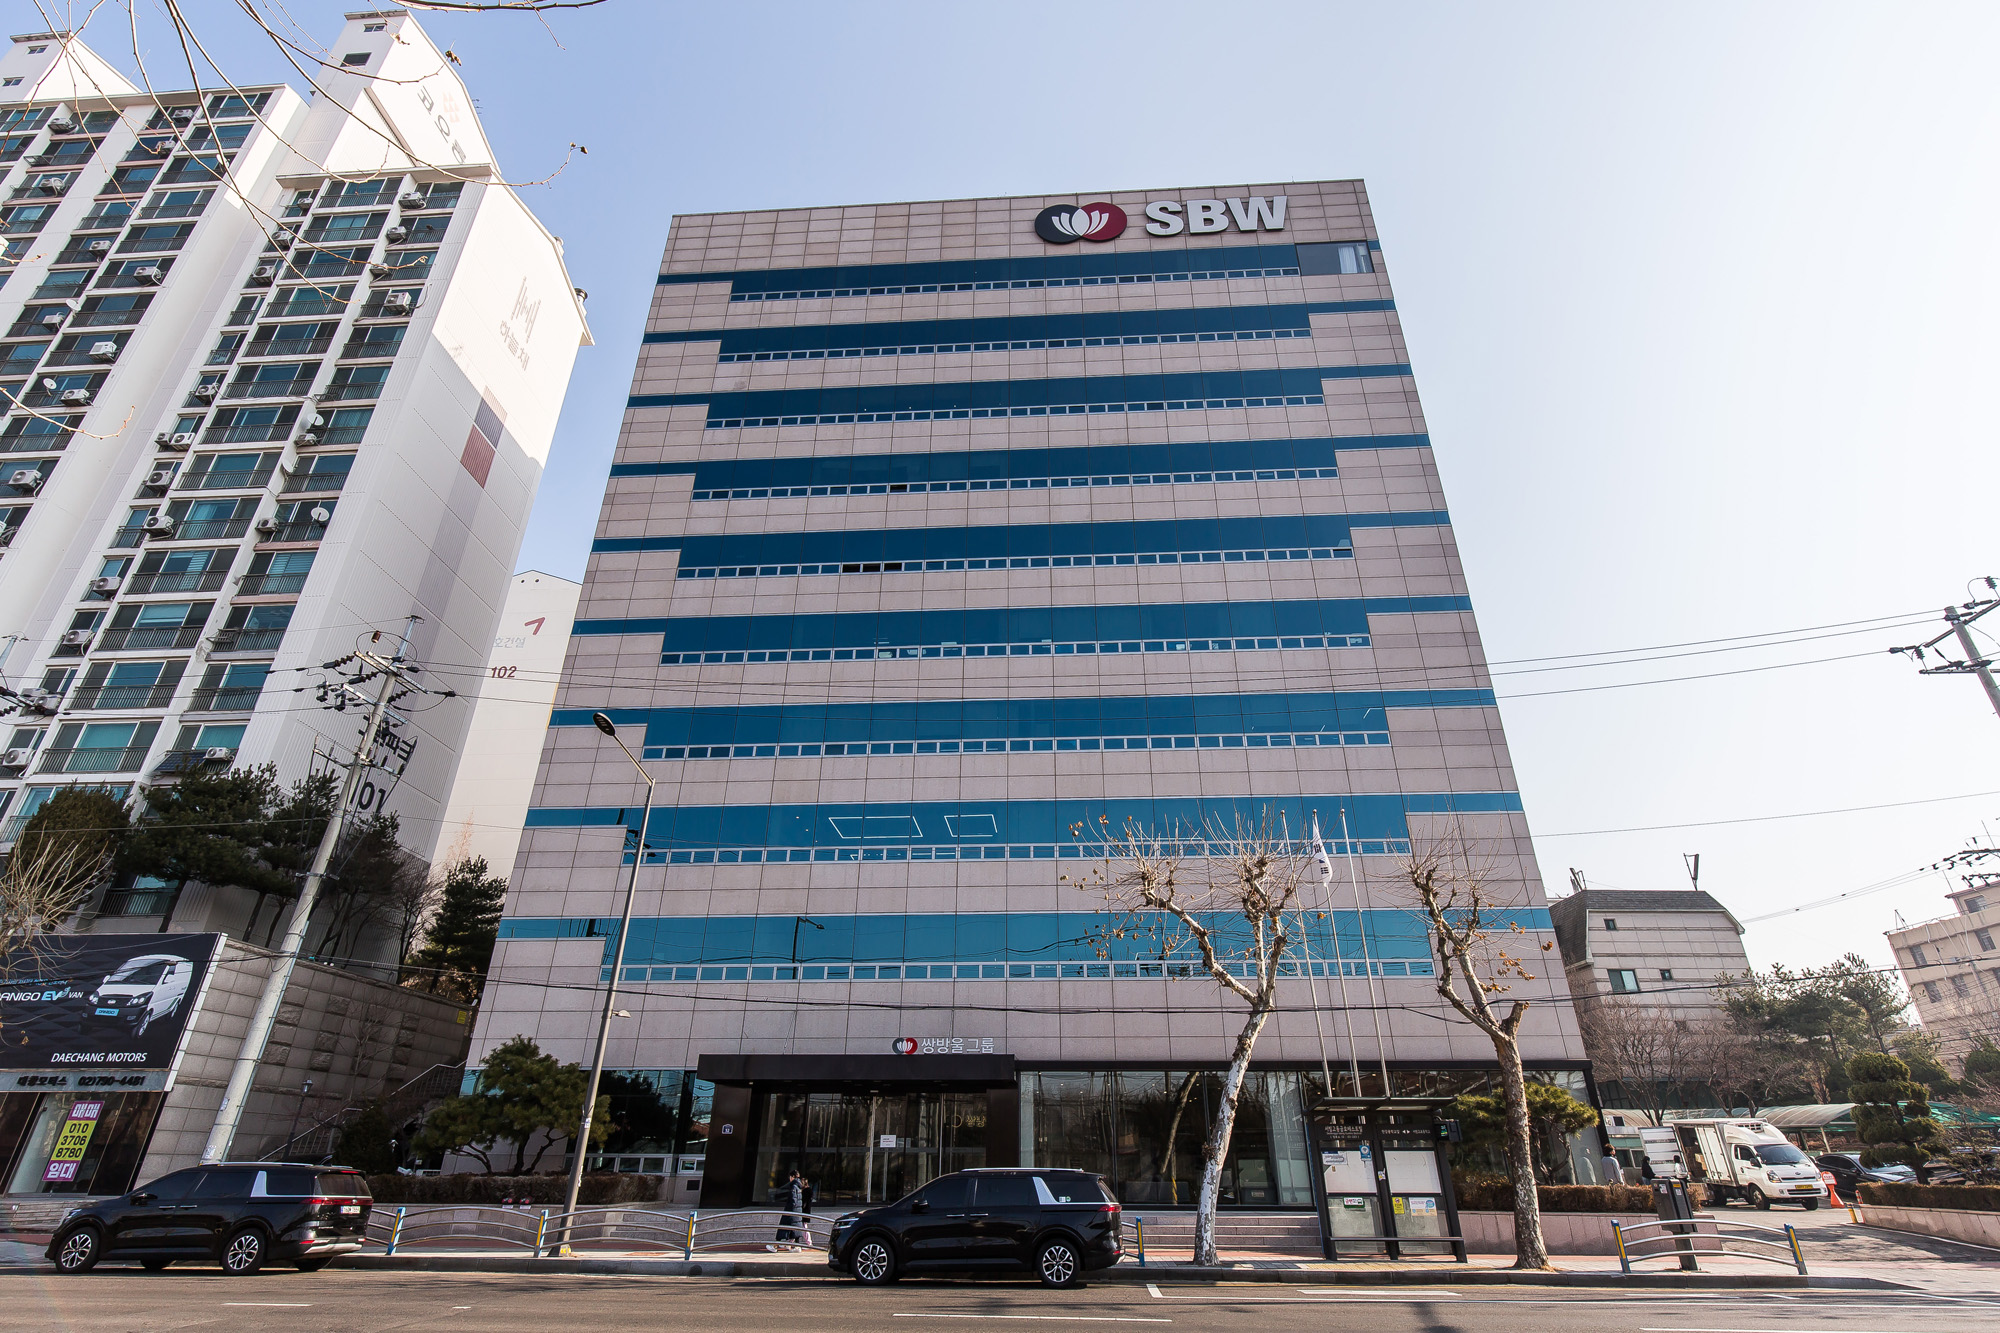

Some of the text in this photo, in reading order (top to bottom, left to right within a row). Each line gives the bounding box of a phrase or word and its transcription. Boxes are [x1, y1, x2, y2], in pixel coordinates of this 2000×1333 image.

[1145, 195, 1288, 236] SBW
[500, 319, 530, 371] 하늘채
[491, 665, 518, 679] 102
[0, 991, 41, 1001] ANIGO
[68, 991, 84, 999] VAN
[921, 1037, 995, 1054] 쌍방울 그룹
[51, 1052, 148, 1063] DAECHANG MOTORS
[71, 1103, 101, 1118] 매매
[69, 1123, 89, 1133] 010
[60, 1135, 87, 1146] 3706
[55, 1147, 82, 1158] 8780
[46, 1162, 77, 1179] 임대
